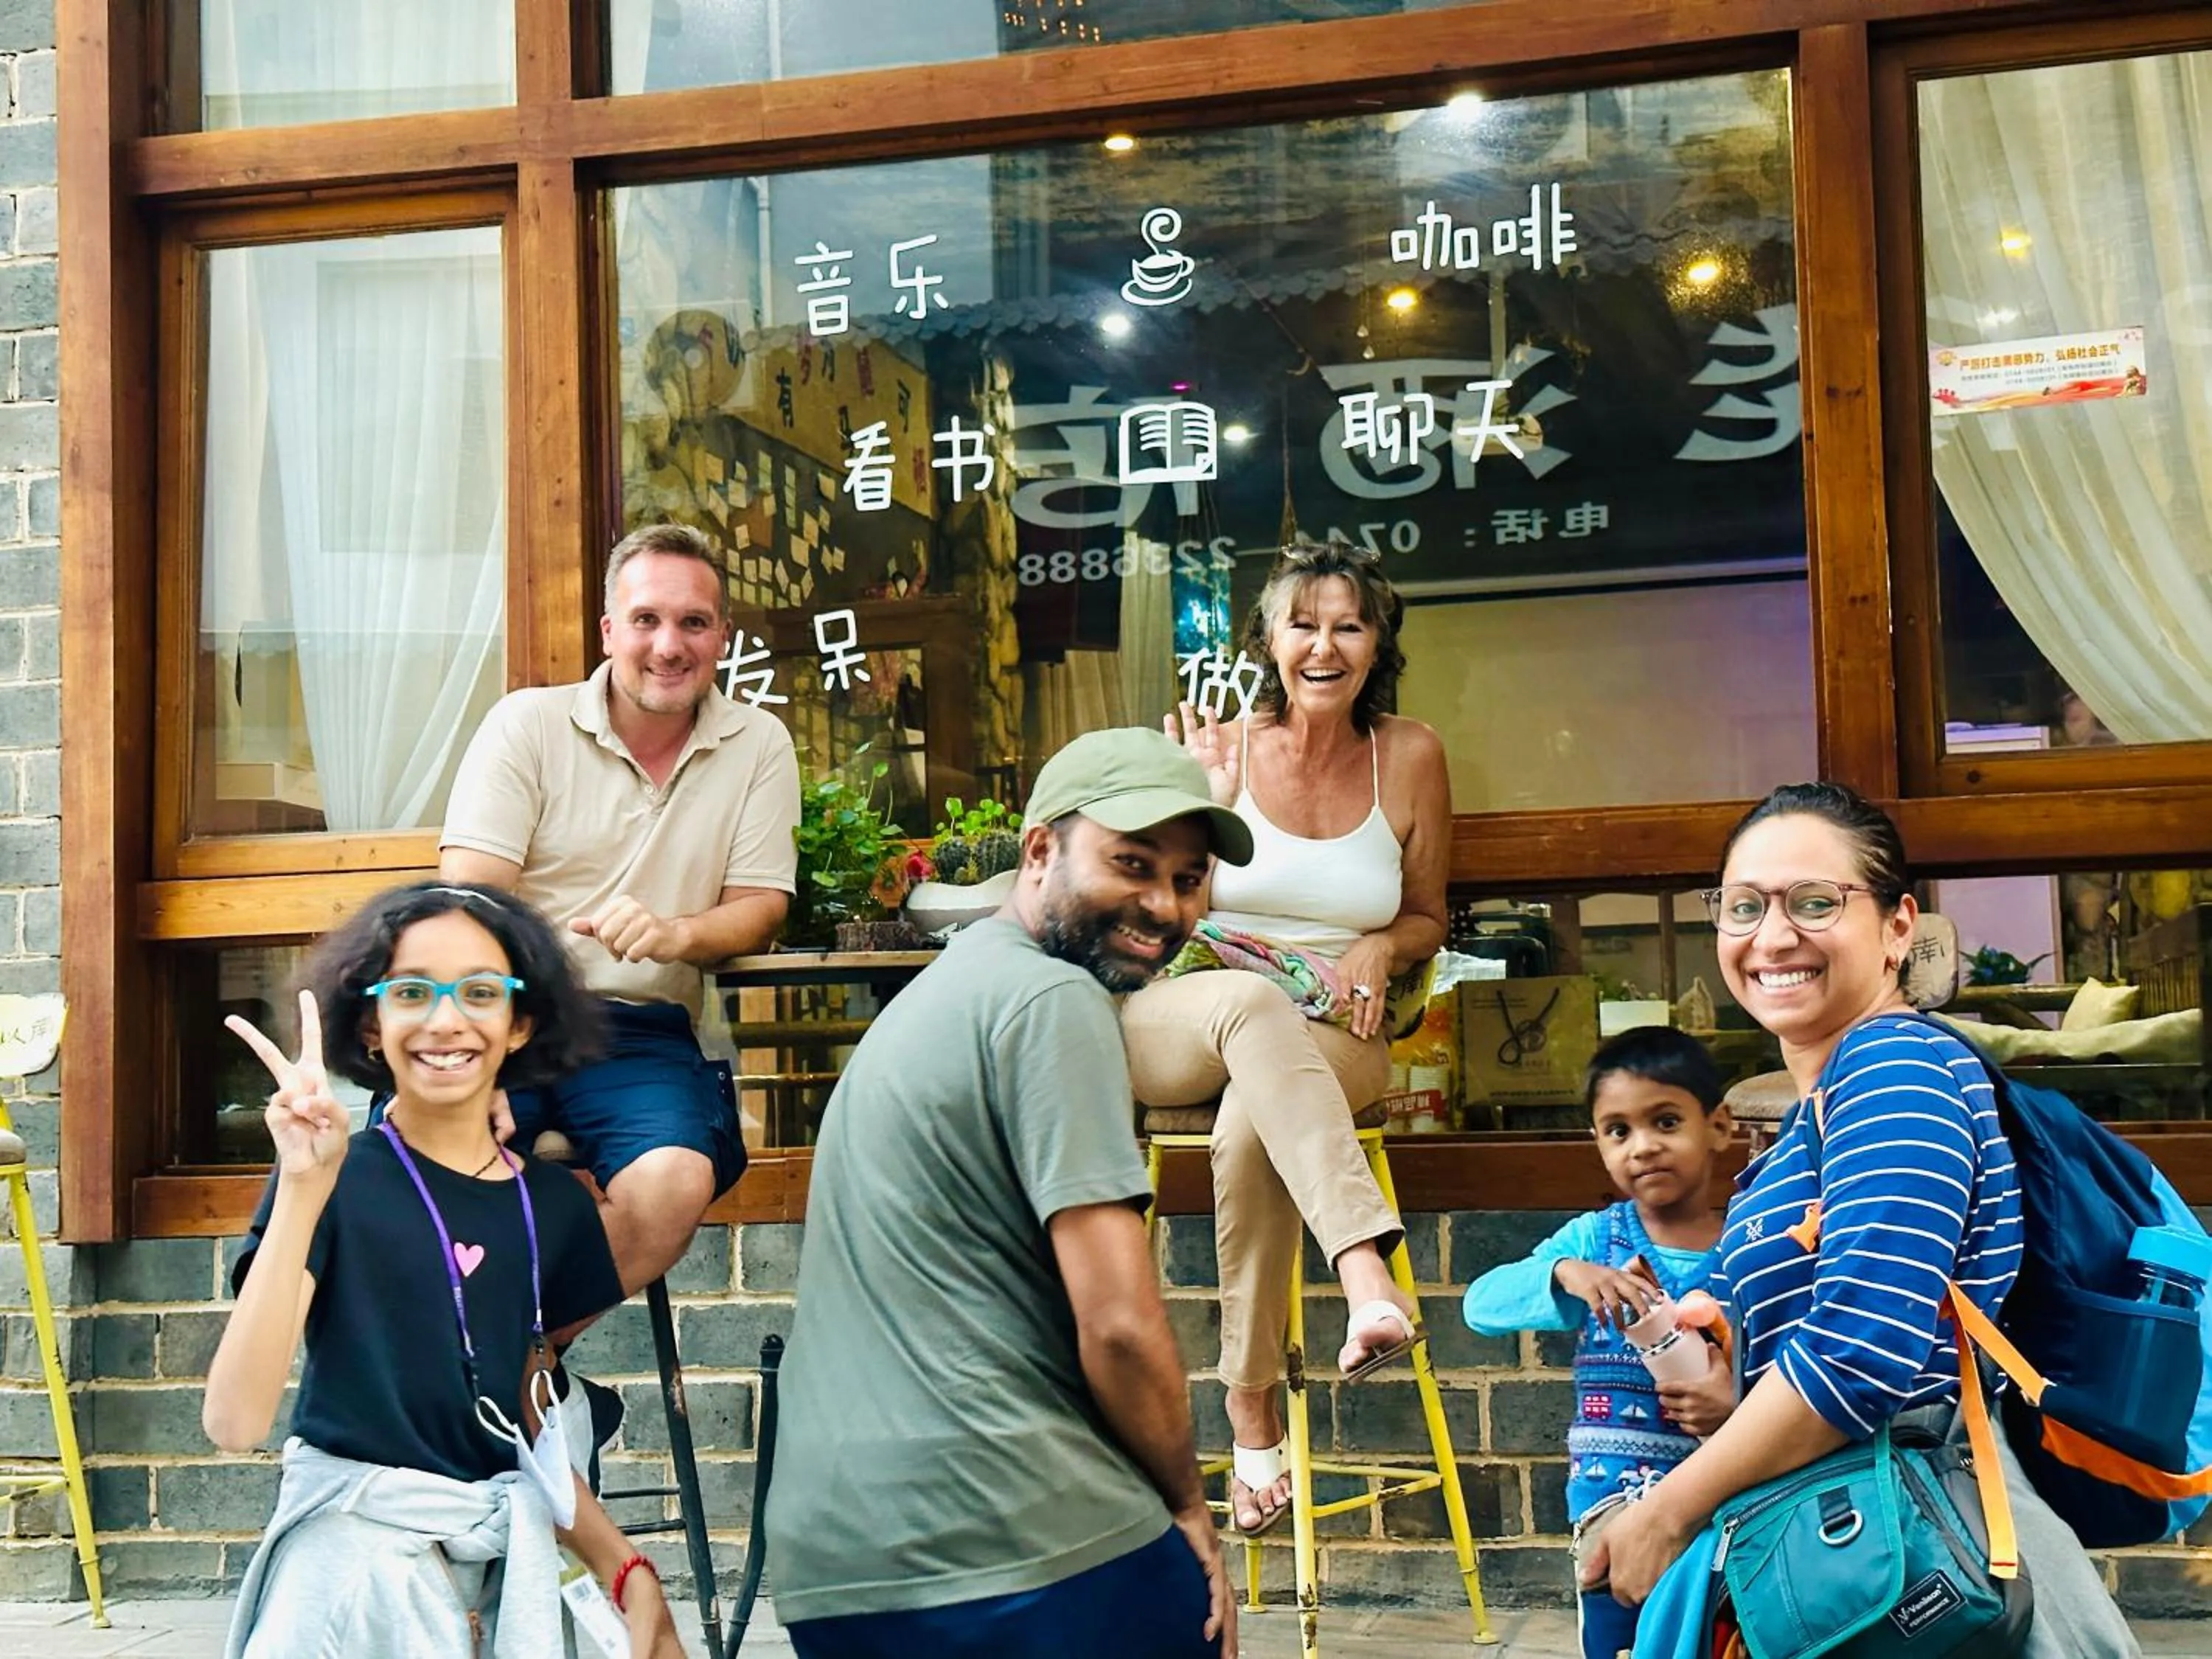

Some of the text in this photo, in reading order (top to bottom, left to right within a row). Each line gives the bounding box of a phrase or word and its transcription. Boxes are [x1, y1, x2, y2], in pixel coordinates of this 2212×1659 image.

[1391, 183, 1576, 270] 咖啡
[795, 235, 948, 335] 音乐
[844, 417, 995, 510] 看书
[1339, 380, 1523, 465] 聊天
[716, 609, 870, 707] 发呆
[1178, 643, 1264, 720] 做
